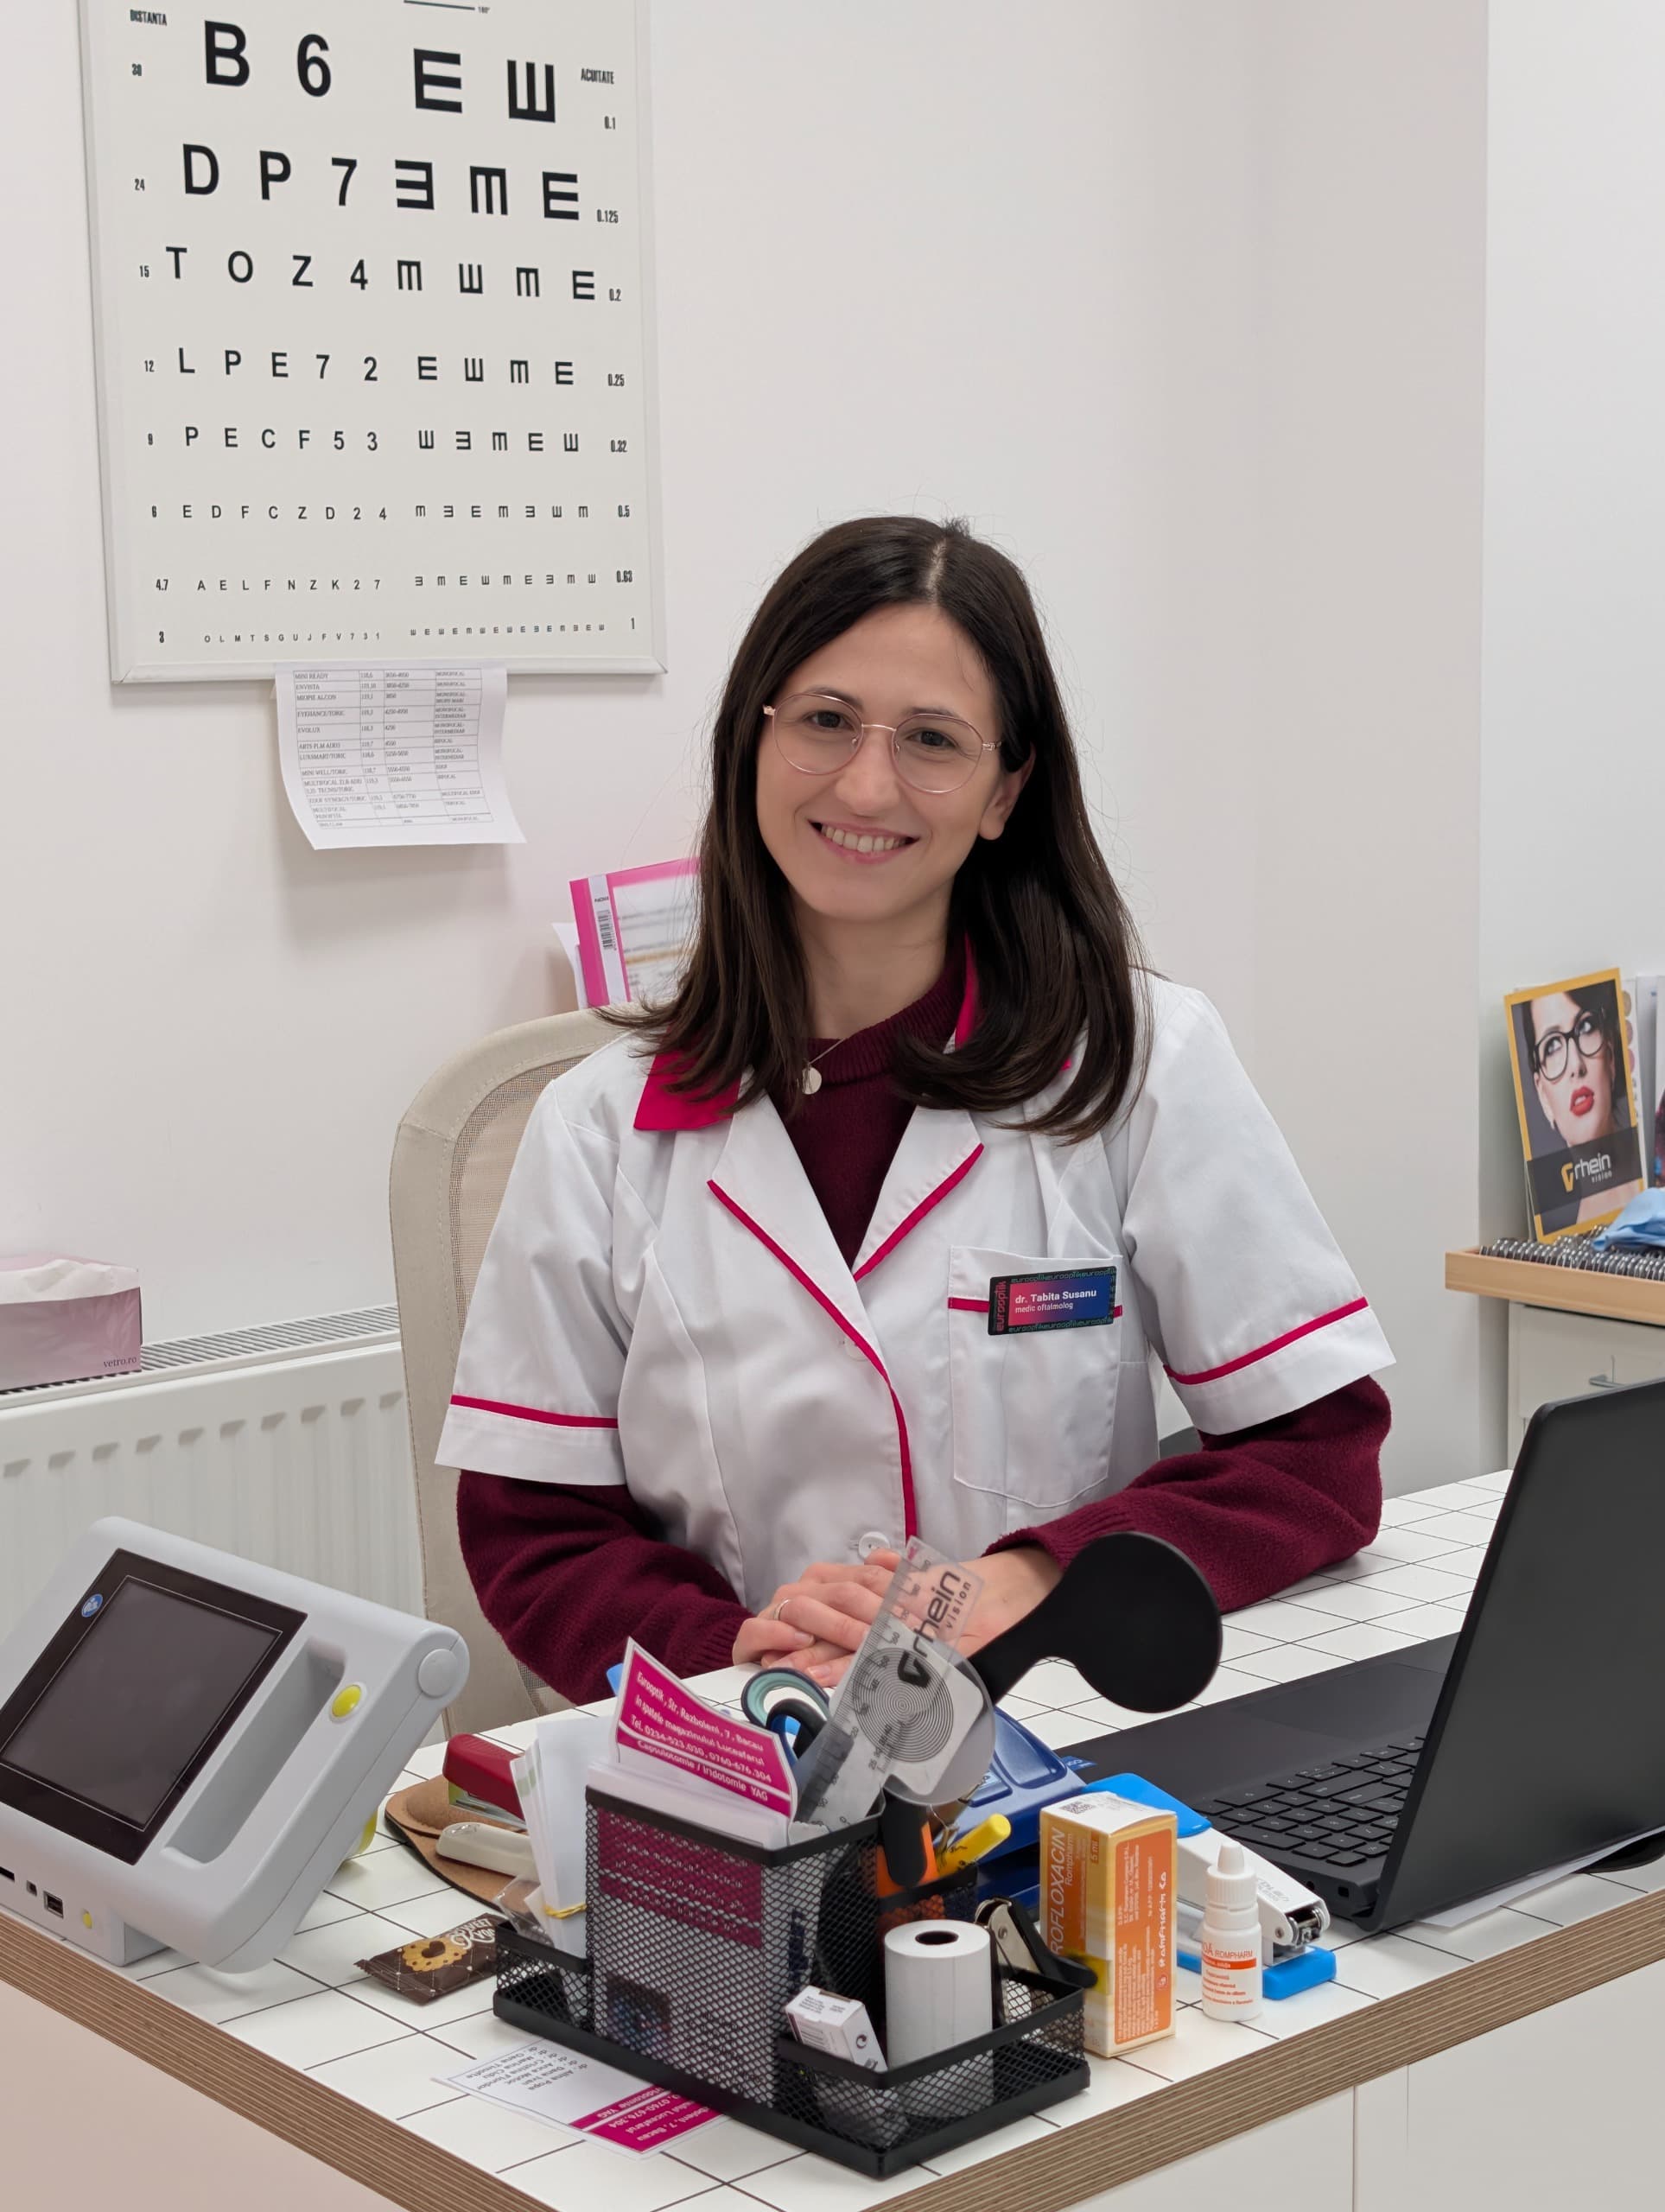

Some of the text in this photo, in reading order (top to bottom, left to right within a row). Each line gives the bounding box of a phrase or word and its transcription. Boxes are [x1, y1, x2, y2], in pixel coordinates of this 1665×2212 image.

[130, 9, 168, 27] DISTANTA
[205, 20, 250, 86] B
[297, 34, 331, 97] 6
[580, 67, 615, 85] ACUITATE
[604, 115, 616, 130] 0.1
[134, 143, 619, 224] 24 D P 7 0.125
[139, 246, 622, 302] 15 T O Z 4 0.2
[144, 347, 625, 387] 12 L P E 7 2 0.25
[186, 426, 199, 446] P
[225, 428, 238, 448] E
[262, 429, 276, 448] C
[299, 429, 310, 449] F
[334, 431, 344, 450] 5
[367, 432, 378, 451] 3
[183, 505, 192, 518] E
[212, 505, 221, 518] D
[242, 505, 249, 518] F
[269, 506, 278, 518] C
[298, 506, 307, 519] Z
[326, 507, 334, 519] D
[353, 507, 360, 519] 2
[379, 507, 386, 520] 4
[617, 504, 631, 518] 0.5
[156, 578, 169, 591] 4.7
[198, 581, 206, 590] A
[220, 580, 227, 590] E
[243, 581, 249, 590] L
[264, 580, 270, 590] F
[289, 580, 296, 590] N
[310, 580, 317, 590] Z
[332, 580, 339, 589] K
[354, 580, 359, 589] 2
[375, 580, 380, 589] 7
[1574, 1152, 1611, 1181] rhein
[1014, 1290, 1097, 1304] dr. Tabita Susanu
[1015, 1301, 1074, 1313] medic oftalmolog
[103, 1356, 137, 1368] vetro.ro
[913, 1571, 962, 1658] rhein
[945, 1581, 972, 1630] vision
[664, 1719, 715, 1747] magazinului
[716, 1740, 766, 1766] Luceafarul
[735, 1733, 764, 1751] Bacau
[637, 1740, 696, 1769] Capsulotomie
[702, 1764, 747, 1791] Iridotomie
[750, 1786, 768, 1802] YAG
[1064, 1833, 1074, 1886] Rompharm
[1214, 1949, 1253, 1958] ROMPHARM
[504, 2056, 535, 2069] Marina
